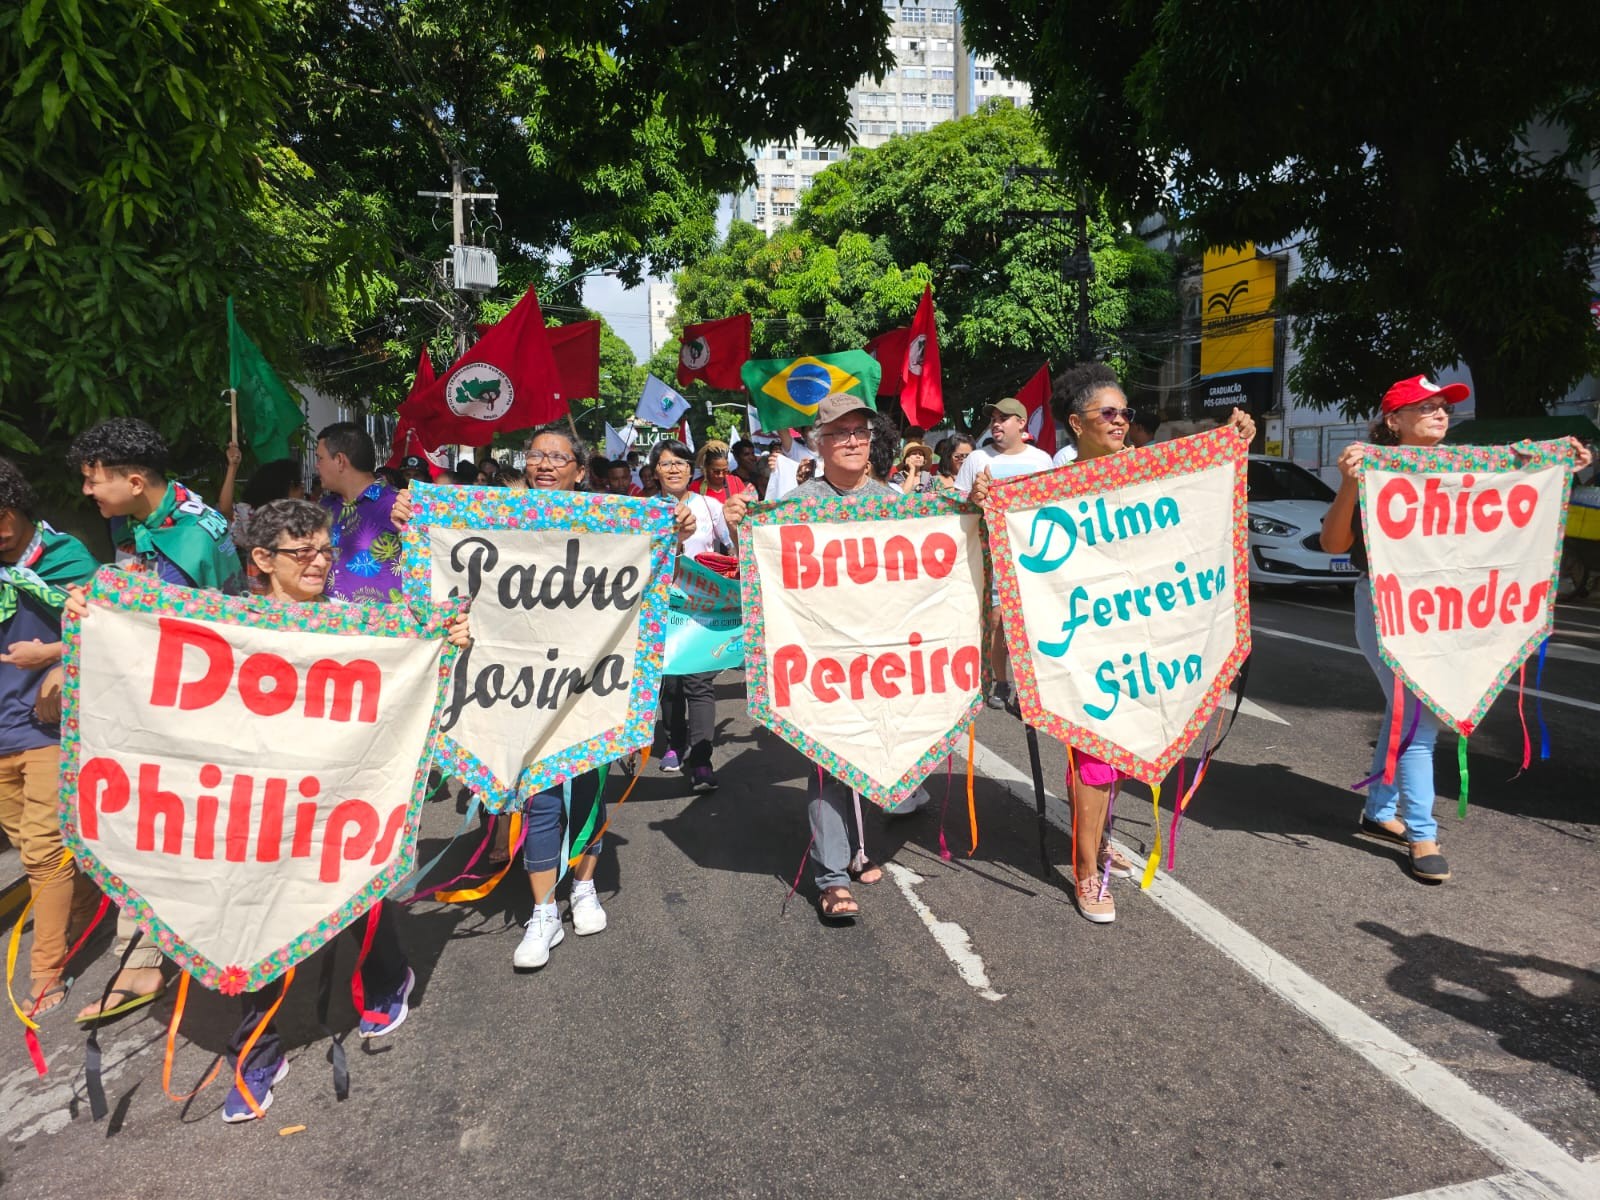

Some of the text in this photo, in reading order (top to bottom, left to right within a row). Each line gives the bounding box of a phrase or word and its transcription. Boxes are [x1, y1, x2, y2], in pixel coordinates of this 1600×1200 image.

[1019, 497, 1181, 573] Dilma
[1376, 474, 1538, 540] Chico
[448, 537, 640, 611] Padre
[780, 525, 957, 589] Bruno
[1375, 569, 1552, 637] Mendes
[150, 617, 382, 723] Dom
[773, 632, 980, 707] Pereira
[1083, 651, 1202, 720] Silva
[78, 757, 408, 883] Phillips
